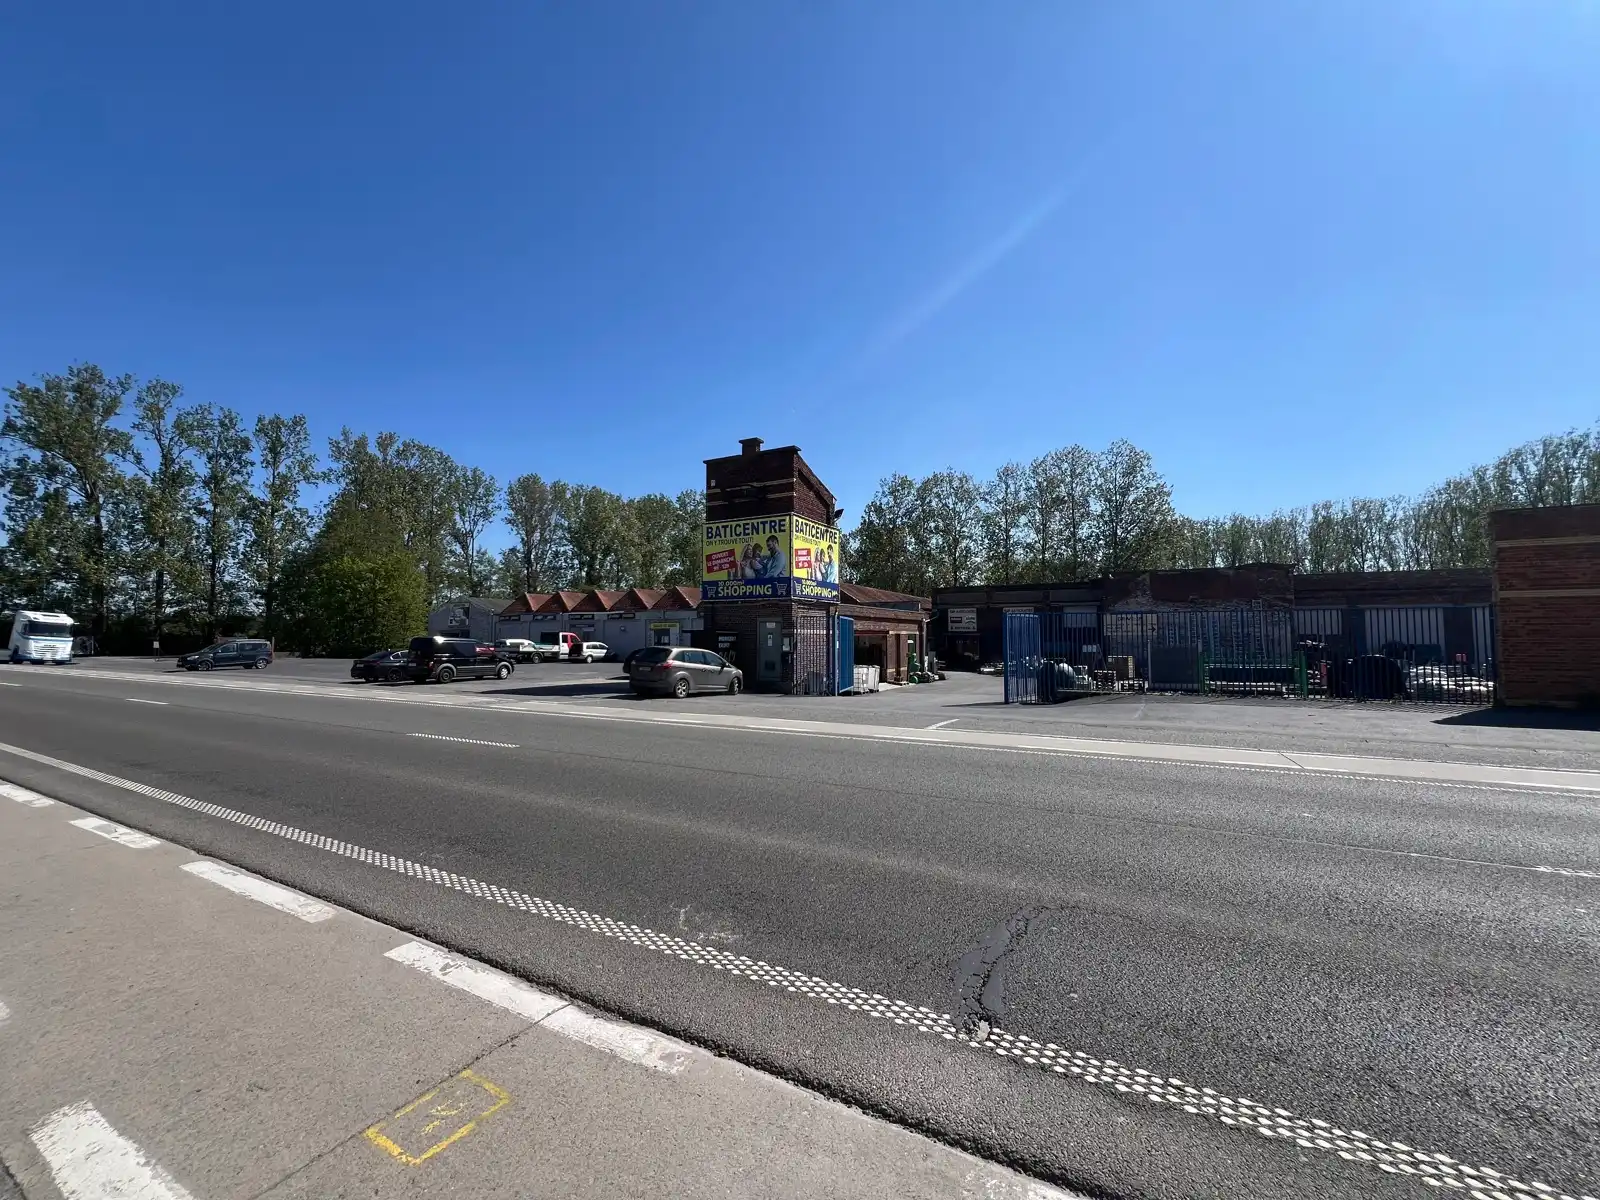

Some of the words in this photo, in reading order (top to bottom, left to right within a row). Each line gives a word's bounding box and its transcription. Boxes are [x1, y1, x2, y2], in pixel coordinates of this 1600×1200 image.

[706, 519, 786, 540] BATICENTRE
[795, 519, 838, 545] BATICENTRE
[718, 538, 738, 546] TROUVE
[718, 584, 772, 597] SHOPPING
[802, 583, 832, 598] SHOPPING
